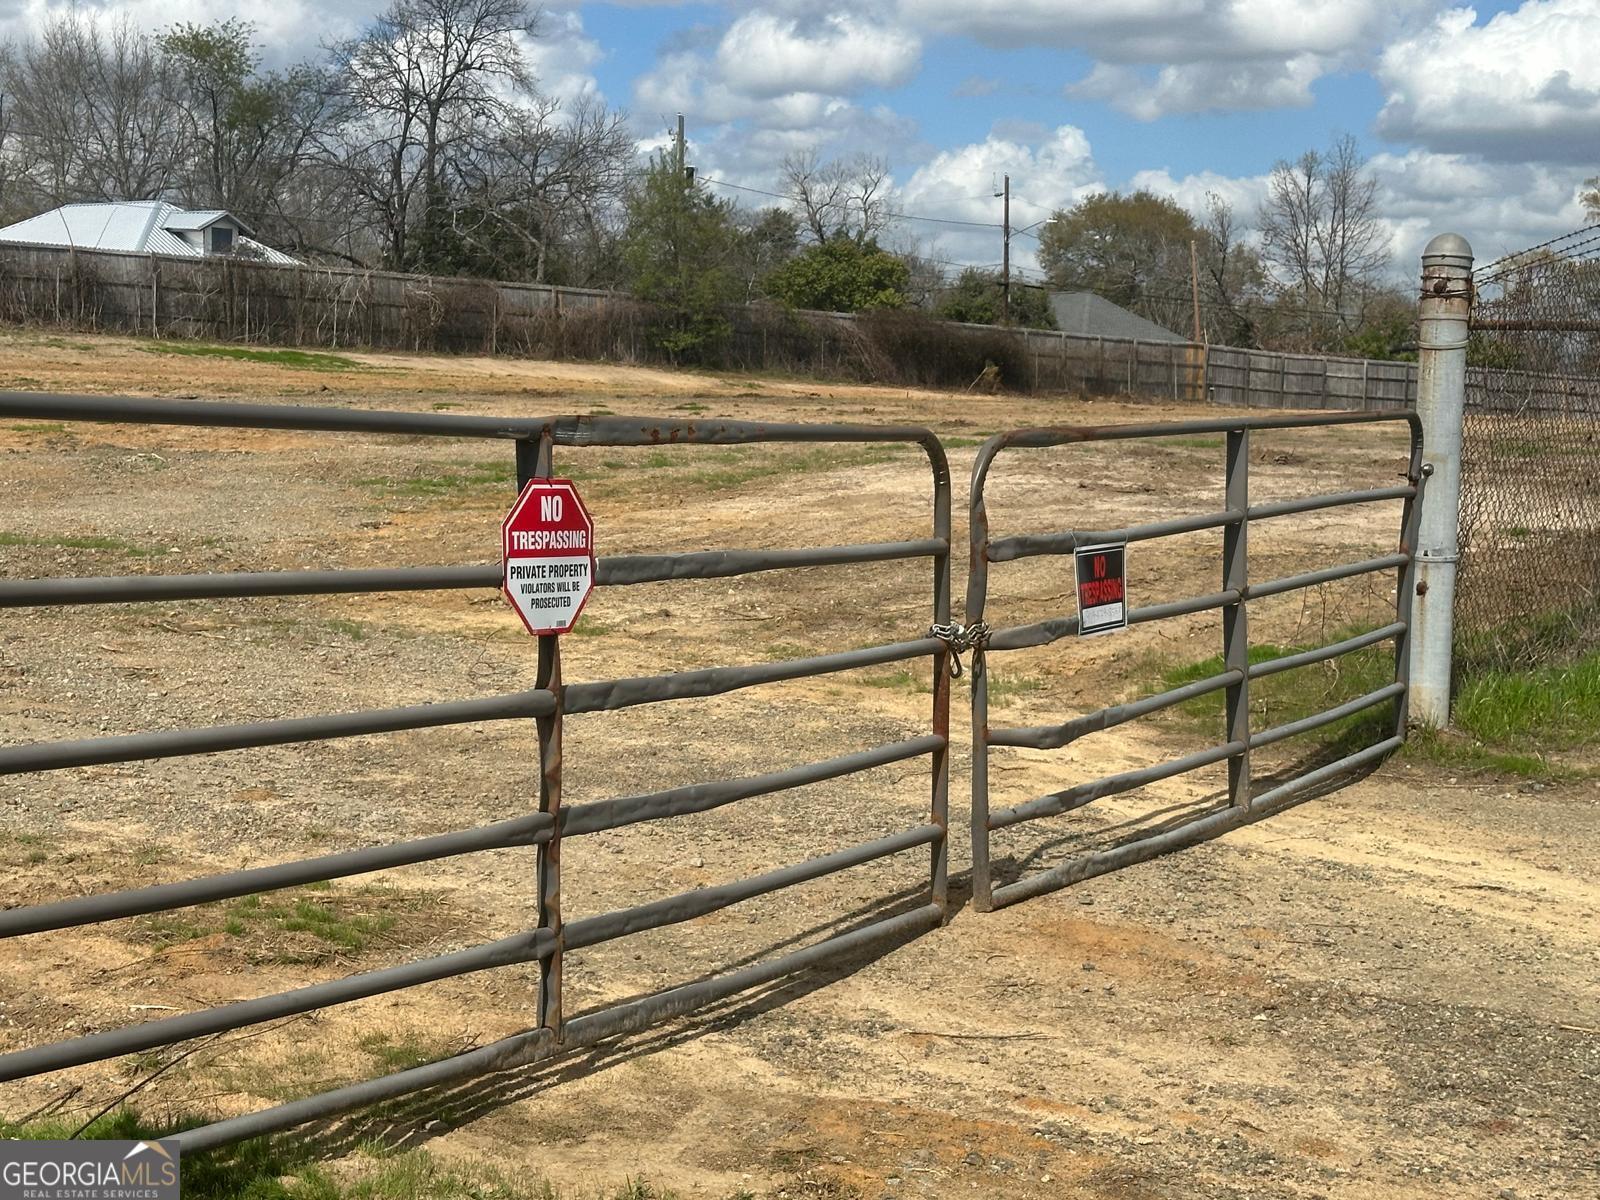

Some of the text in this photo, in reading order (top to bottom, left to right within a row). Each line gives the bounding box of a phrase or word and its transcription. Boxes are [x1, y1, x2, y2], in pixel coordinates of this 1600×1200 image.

[540, 495, 563, 522] NO
[511, 530, 586, 550] TRESPASSING
[510, 563, 588, 580] PRIVATE PROPERTY
[1094, 555, 1106, 577] NO
[520, 581, 580, 594] VIOLATORS WILL BE
[531, 596, 571, 609] PROSECUTED
